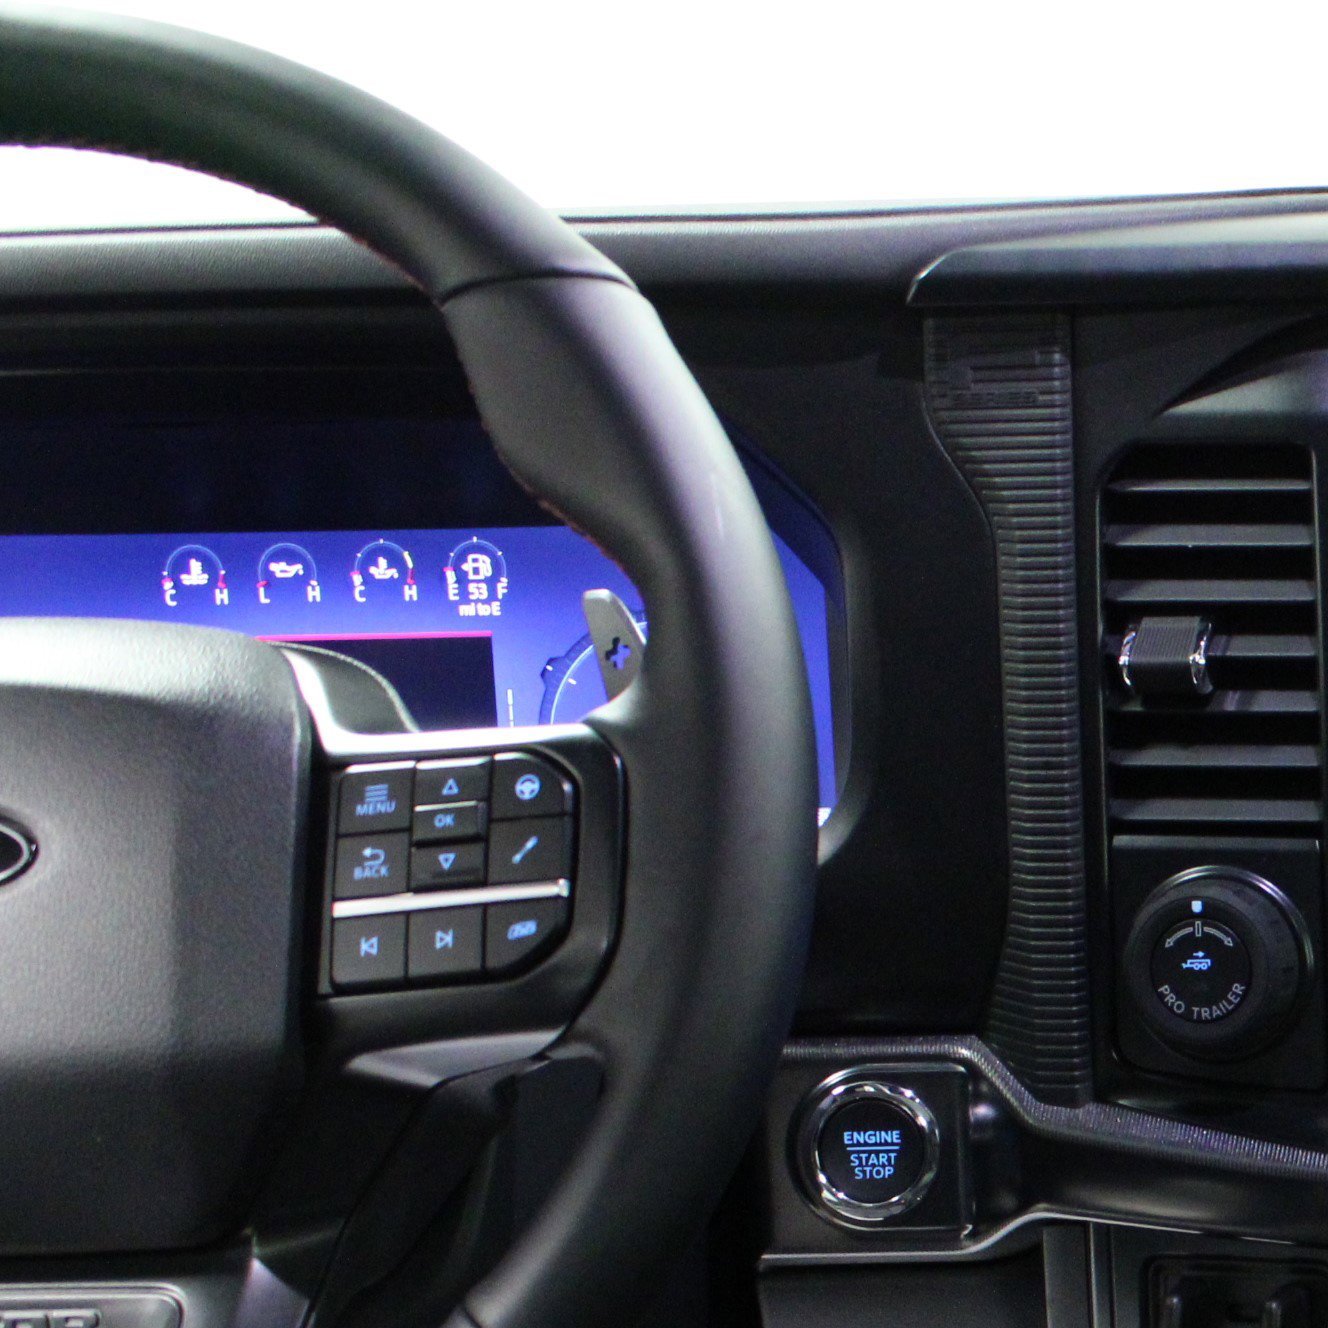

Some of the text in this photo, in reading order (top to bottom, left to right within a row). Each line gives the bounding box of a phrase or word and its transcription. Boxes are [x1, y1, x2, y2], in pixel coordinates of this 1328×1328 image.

[165, 589, 177, 606] C
[215, 588, 229, 605] H
[259, 586, 270, 603] L
[307, 585, 321, 602] H
[354, 584, 366, 602] C
[404, 584, 418, 601] H
[448, 583, 459, 600] E
[467, 582, 488, 600] 53
[497, 582, 508, 600] F
[356, 801, 396, 816] MENU
[434, 813, 455, 828] OK
[353, 865, 389, 881] BACK
[1158, 983, 1246, 1021] PRO TRAILER
[843, 1130, 901, 1144] ENGINE
[850, 1153, 897, 1166] START
[854, 1166, 894, 1180] STOP
